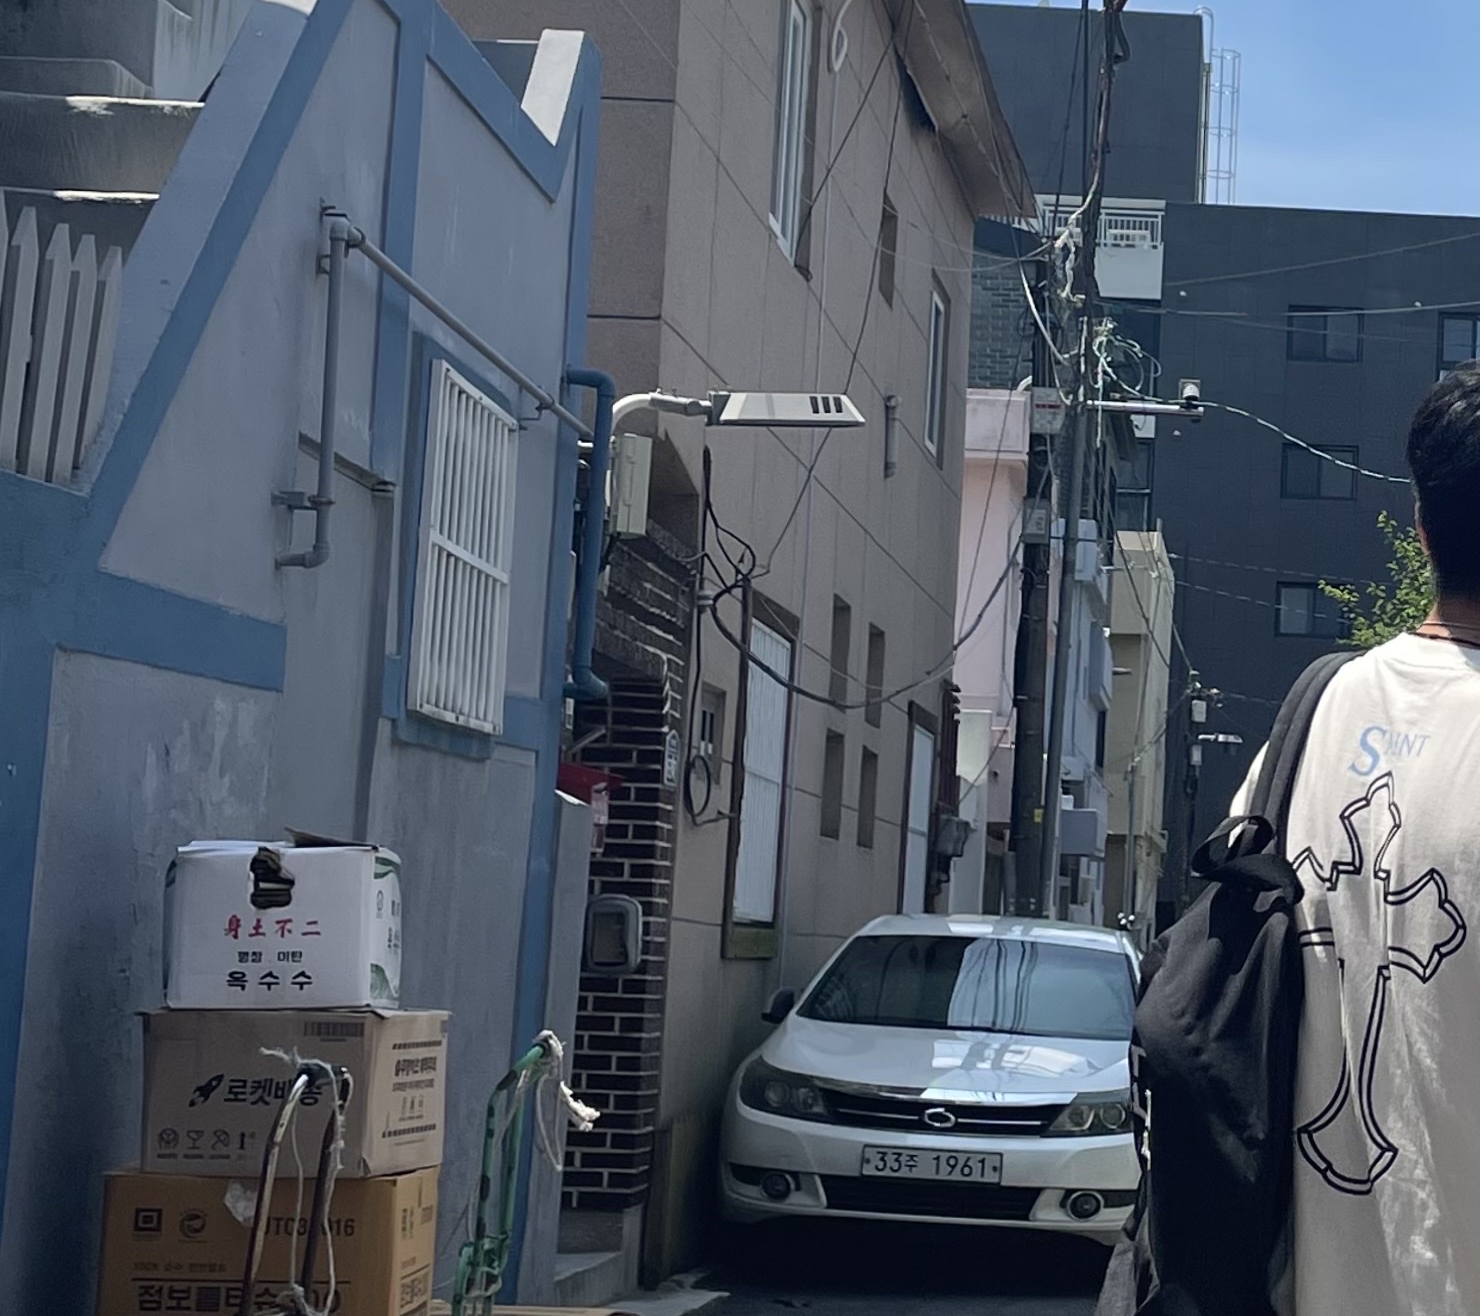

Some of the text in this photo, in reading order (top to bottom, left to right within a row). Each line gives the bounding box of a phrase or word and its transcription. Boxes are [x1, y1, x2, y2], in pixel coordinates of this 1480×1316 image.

[224, 914, 322, 940] 身土不二
[226, 970, 313, 991] 옥수수
[874, 1150, 986, 1178] 33주 1961
